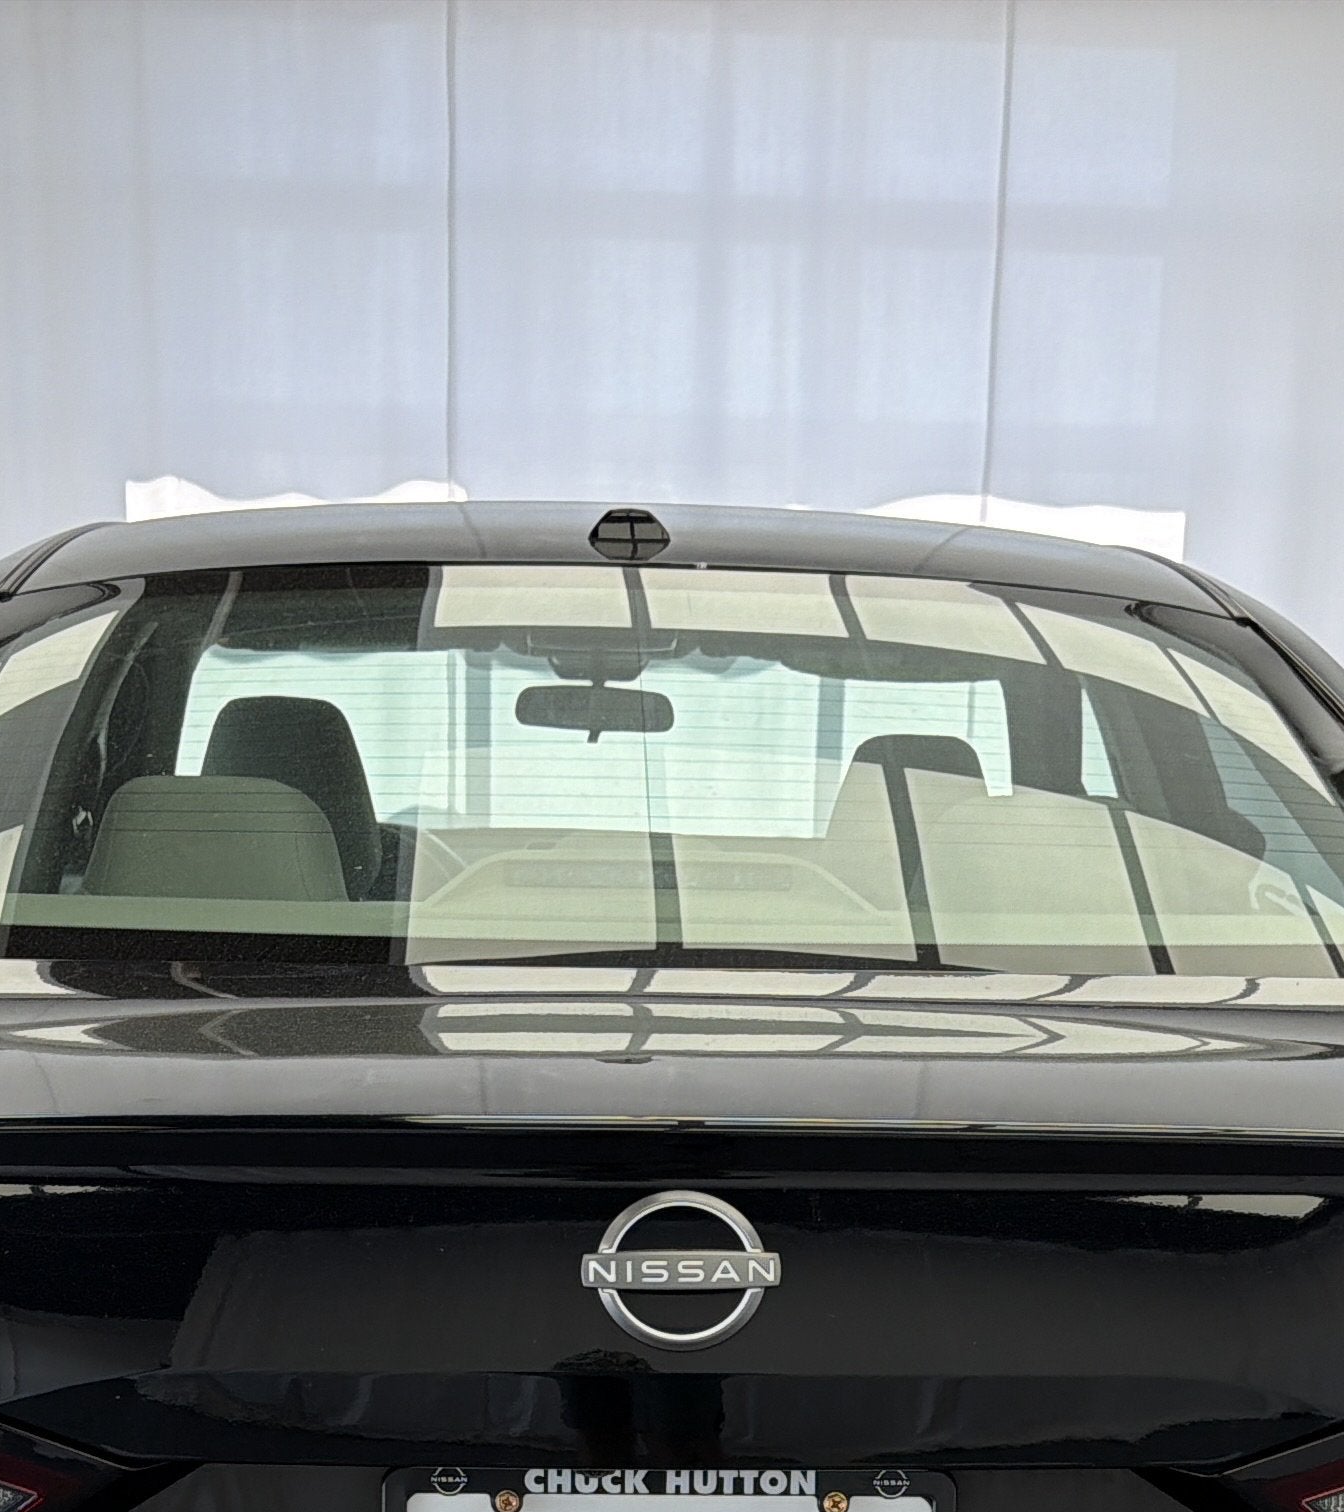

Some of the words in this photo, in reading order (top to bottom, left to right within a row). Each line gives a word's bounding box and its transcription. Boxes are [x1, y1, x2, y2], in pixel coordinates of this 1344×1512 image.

[588, 1260, 775, 1282] NISSAN
[524, 1469, 649, 1494] CHUCK
[665, 1470, 816, 1495] HUTTON
